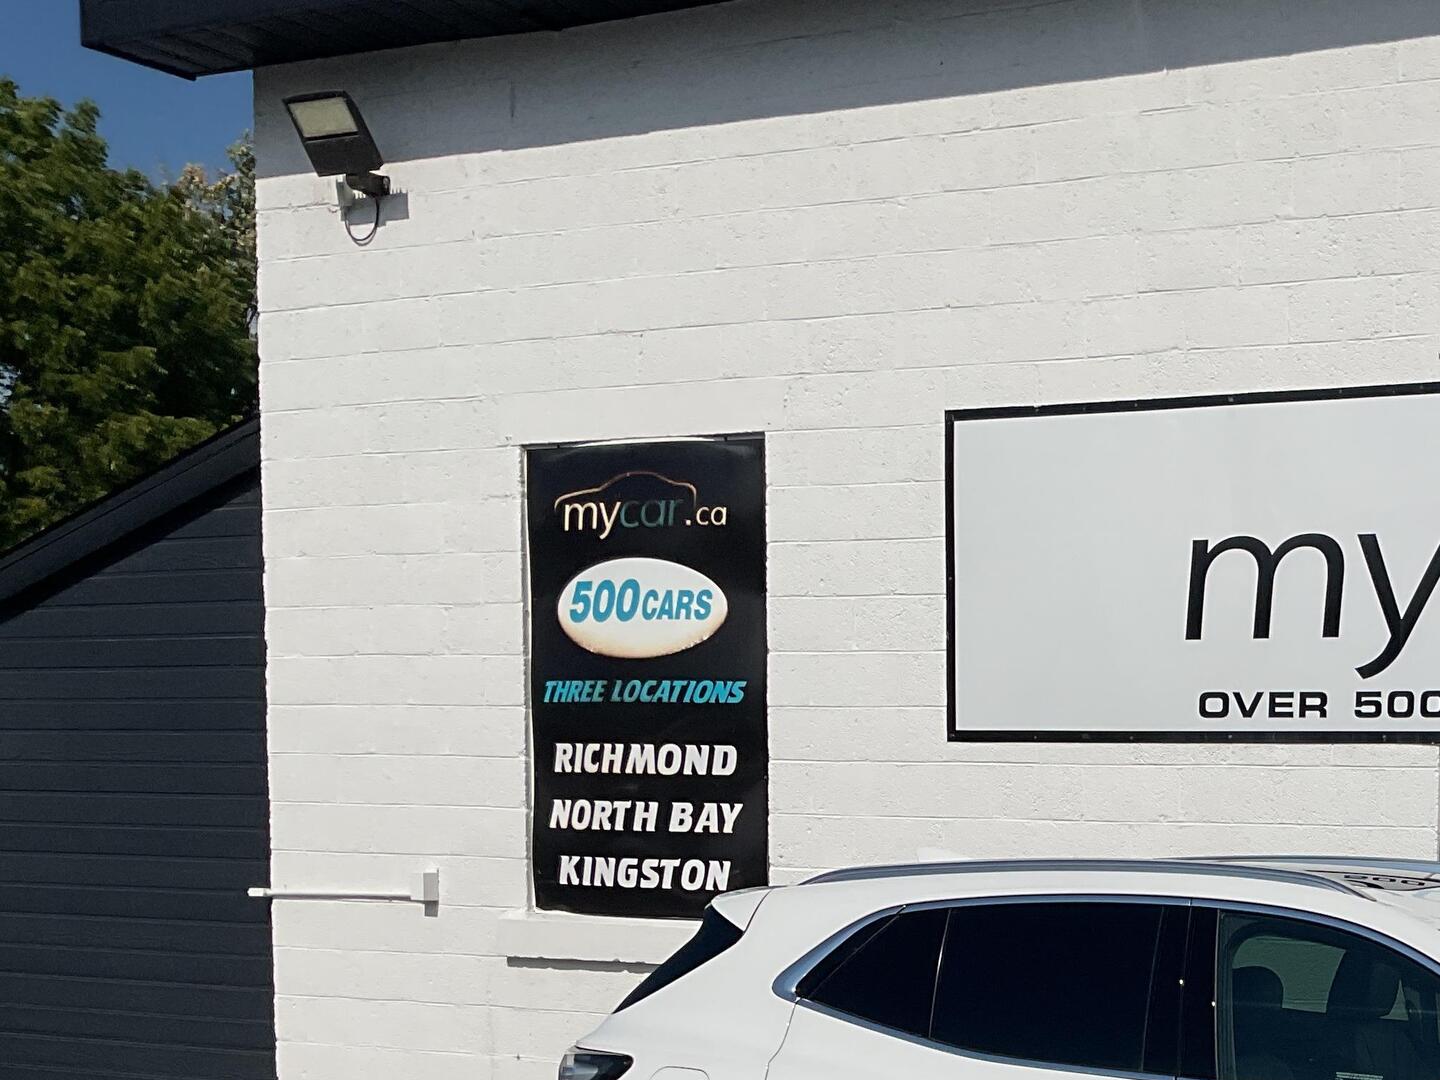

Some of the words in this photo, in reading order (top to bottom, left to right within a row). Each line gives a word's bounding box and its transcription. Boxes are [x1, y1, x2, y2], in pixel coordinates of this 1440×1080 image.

[564, 497, 727, 540] mycar.ca
[570, 578, 642, 622] 500
[642, 589, 713, 620] CARS
[544, 680, 606, 704] THREE
[611, 679, 748, 705] LOCATIONS
[1198, 691, 1328, 719] OVER
[554, 743, 738, 776] RICHMOND
[550, 798, 658, 832] NORTH
[668, 801, 744, 834] BAY
[558, 855, 732, 891] KINGSTON
